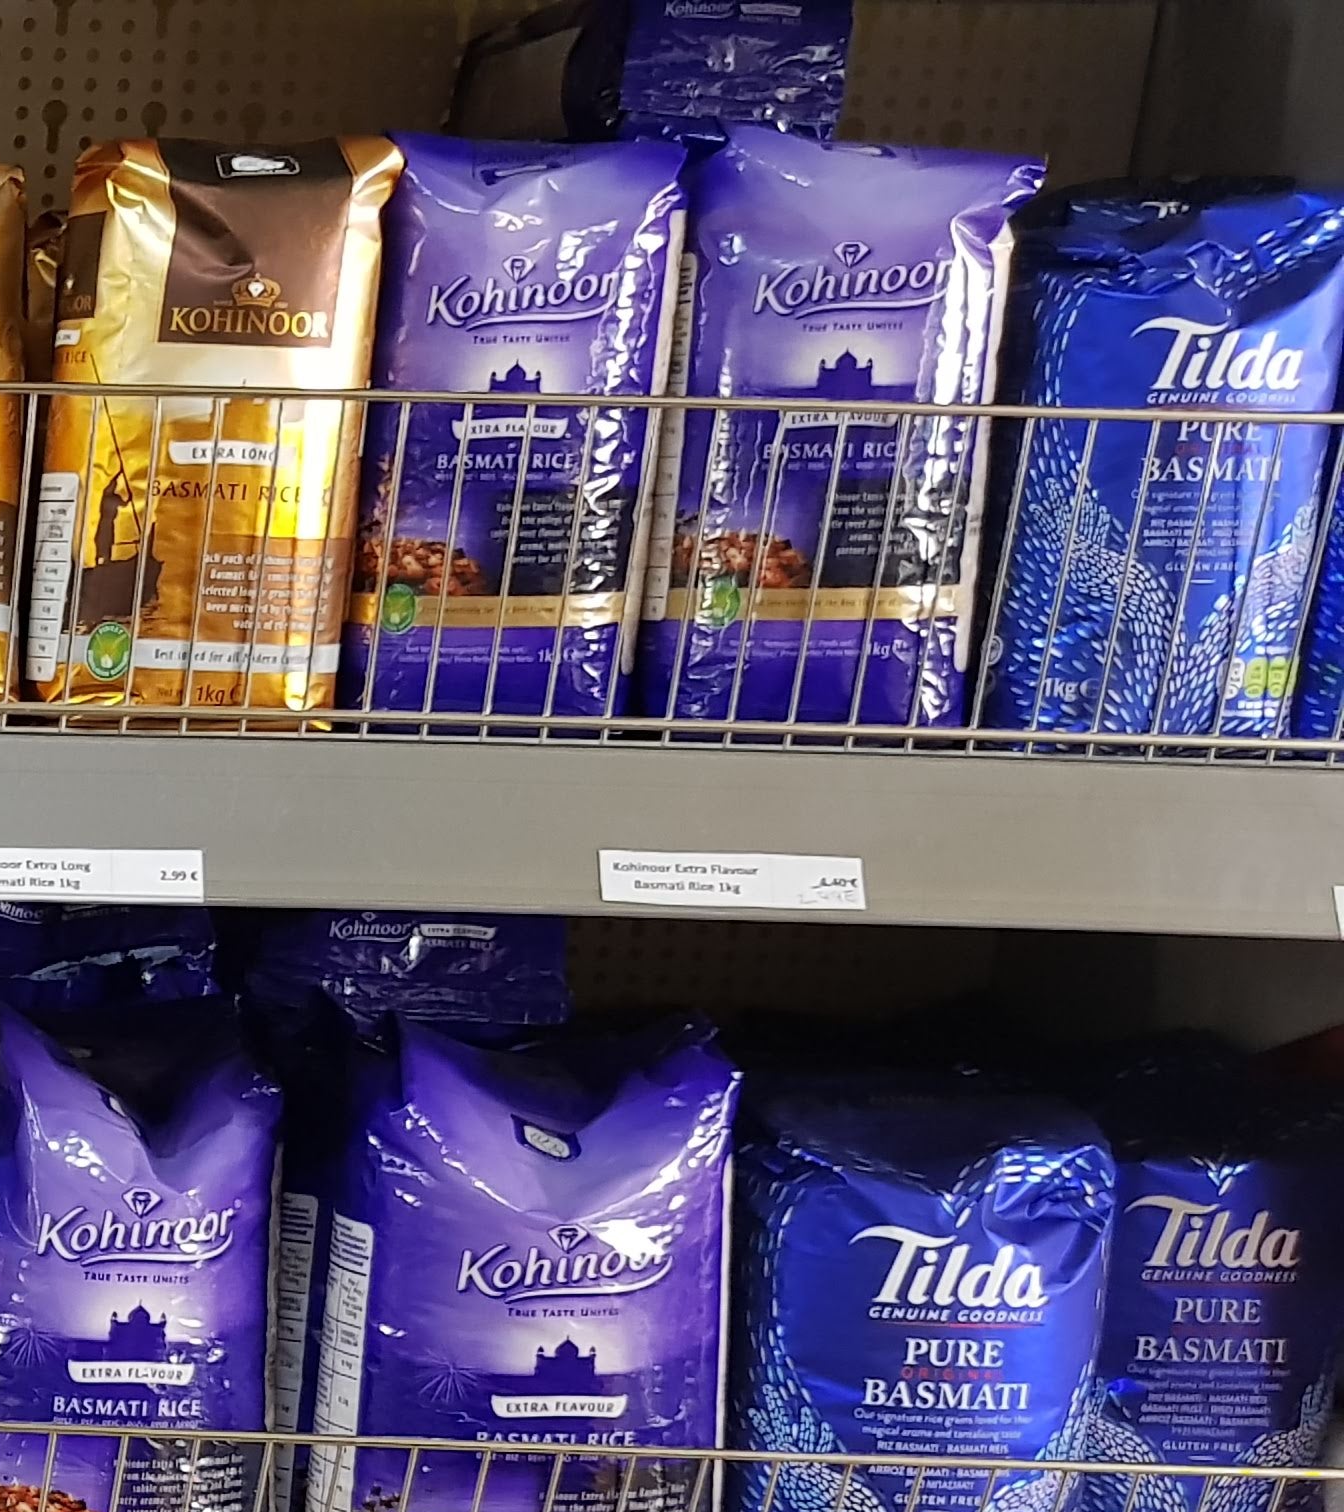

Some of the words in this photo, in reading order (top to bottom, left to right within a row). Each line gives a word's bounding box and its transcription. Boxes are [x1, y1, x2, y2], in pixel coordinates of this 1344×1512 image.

[170, 307, 329, 338] KOHINOOR
[1131, 317, 1304, 392] Tilda
[1147, 393, 1221, 404] GENUINE
[26, 860, 57, 870] Extra
[61, 861, 91, 873] Long
[160, 870, 187, 881] 2.99
[613, 862, 670, 873] Kohinoor
[675, 863, 707, 874] Extra
[30, 877, 55, 887] Rice
[59, 878, 81, 890] 1kg
[634, 880, 685, 891] Basmati
[688, 881, 713, 891] Rice
[719, 882, 741, 894] 1kg
[38, 1206, 233, 1266] Kohinoor
[1125, 1195, 1302, 1269] Tilda
[850, 1227, 1047, 1306] Tilda
[1143, 1269, 1212, 1281] GENUINE
[1221, 1270, 1298, 1283] GOODNESS
[869, 1306, 950, 1320] GENUINE
[958, 1308, 1043, 1324] GOODNESS
[1173, 1298, 1260, 1324] PURE
[903, 1337, 1005, 1367] PURE
[1135, 1335, 1289, 1364] BASMATI
[82, 1367, 122, 1378] EXTRA
[128, 1369, 183, 1380] FLAVOUR
[862, 1378, 1030, 1410] BASMATI
[52, 1396, 148, 1415] BASMATI
[158, 1398, 201, 1417] RICE
[507, 1400, 547, 1414] EXTRA
[554, 1401, 615, 1415] FLAVOUR
